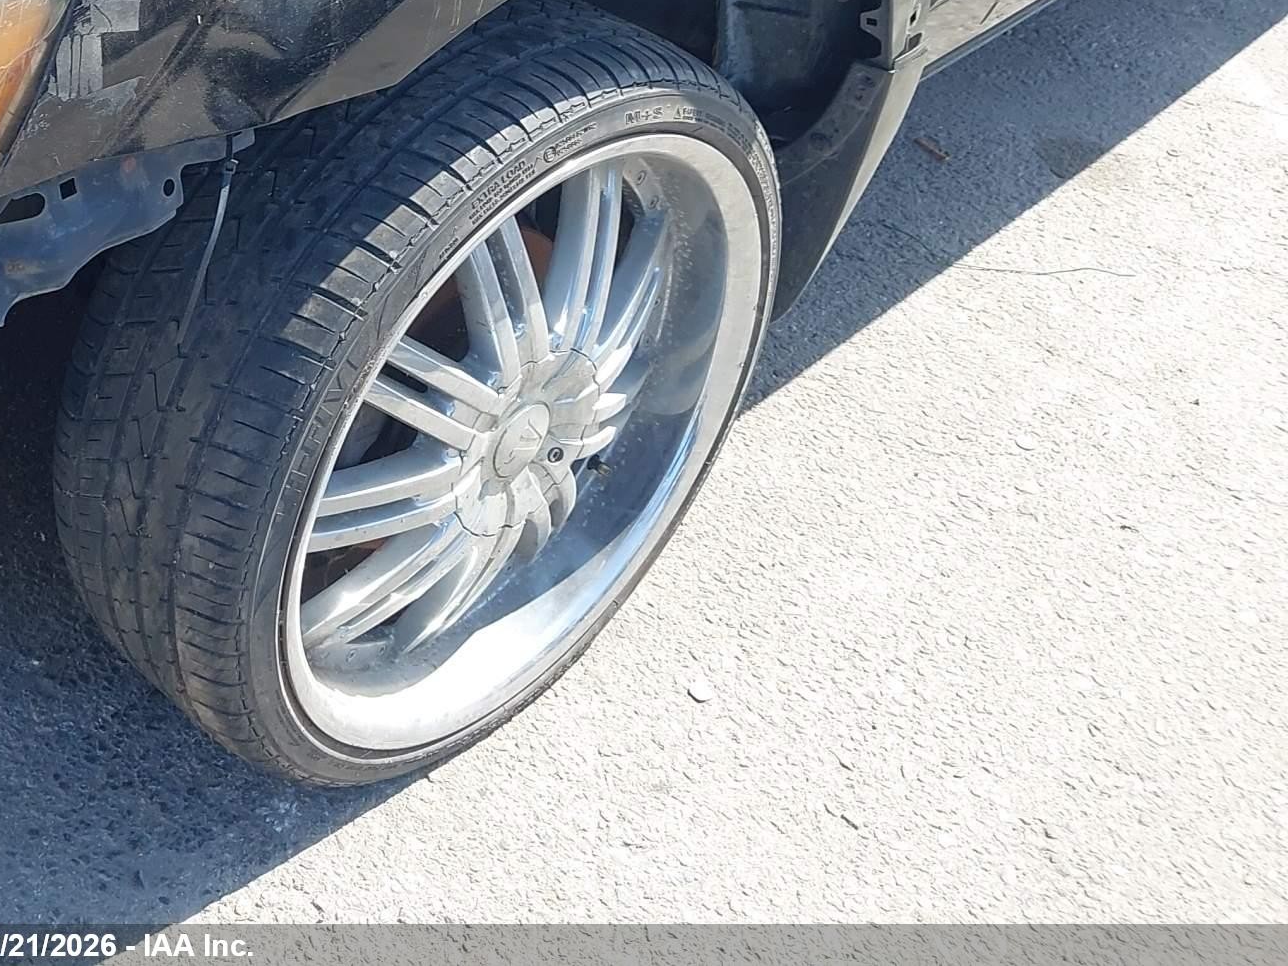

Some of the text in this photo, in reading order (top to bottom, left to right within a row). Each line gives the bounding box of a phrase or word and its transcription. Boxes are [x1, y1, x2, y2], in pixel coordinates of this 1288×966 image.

[624, 106, 664, 126] M+S
[470, 180, 500, 210] EXTRA
[498, 159, 527, 184] LOAD
